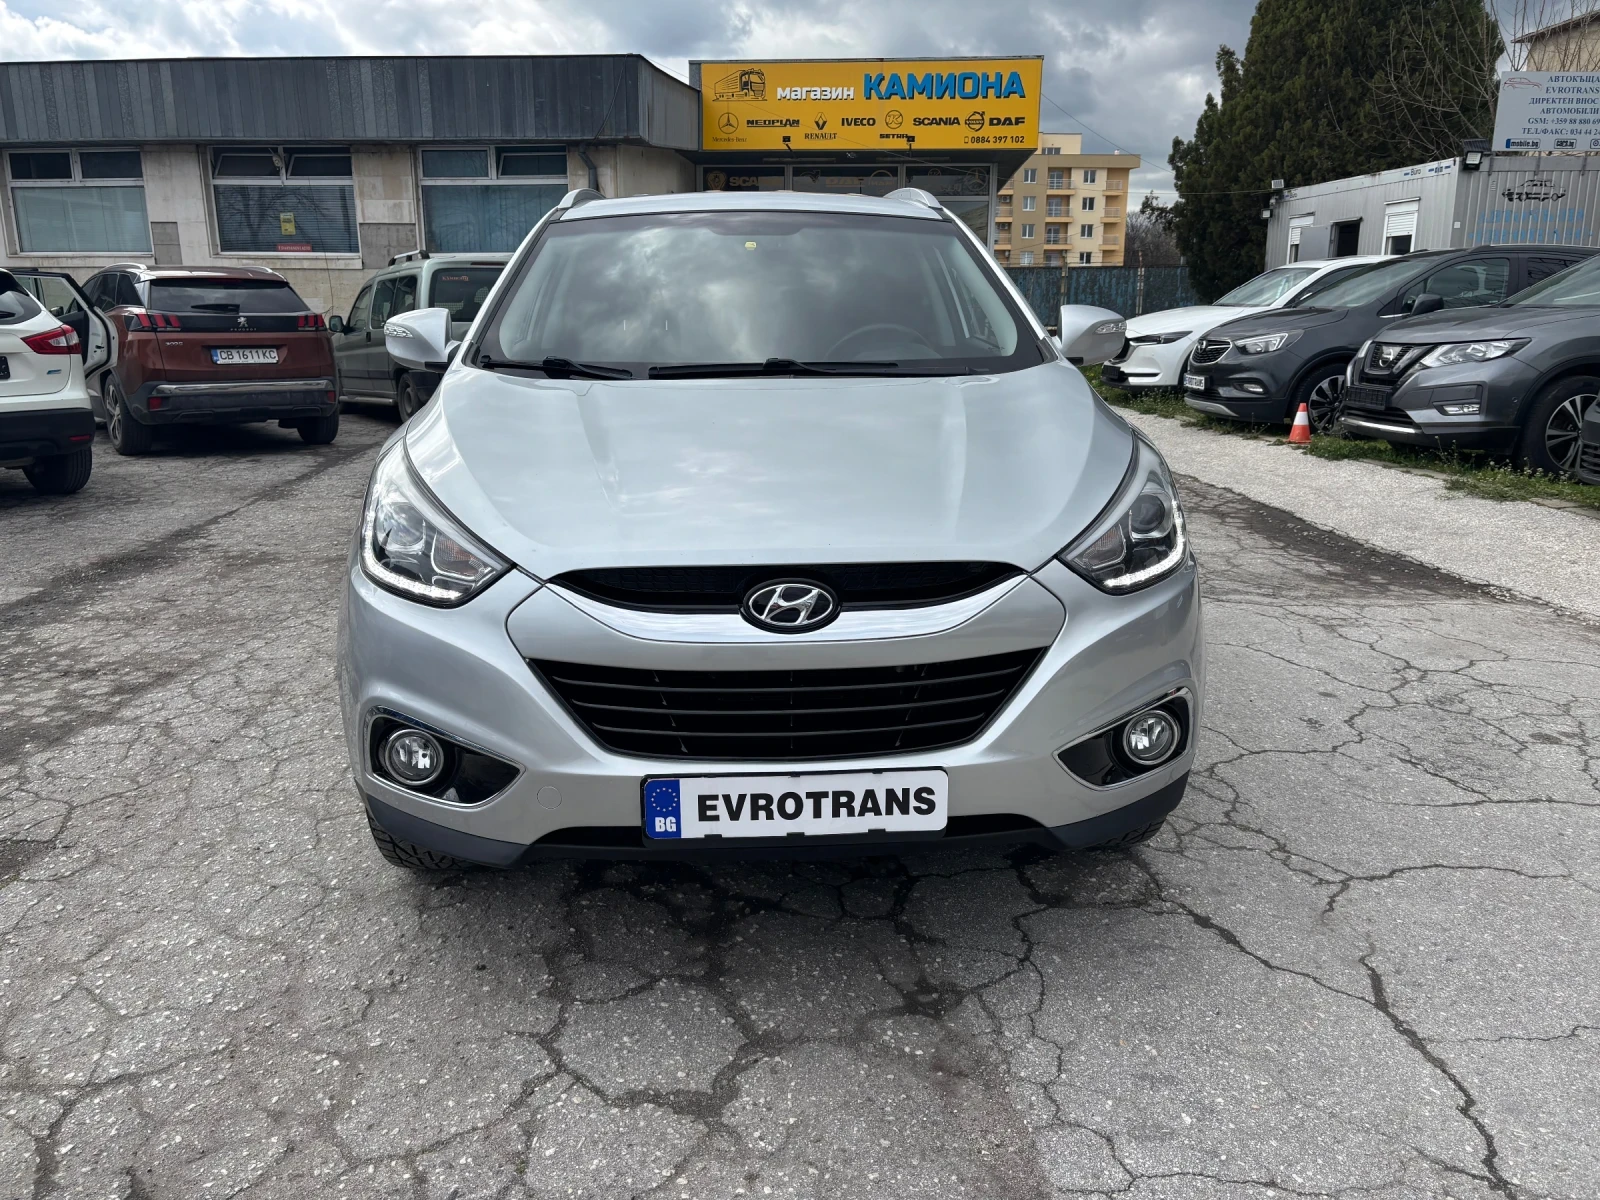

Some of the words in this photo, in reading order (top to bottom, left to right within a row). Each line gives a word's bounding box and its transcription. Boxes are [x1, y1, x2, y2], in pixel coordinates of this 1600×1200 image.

[1547, 75, 1600, 84] АВТОКЪЩА
[776, 86, 855, 101] магазин
[863, 71, 1026, 100] КАМИОНА
[1545, 86, 1600, 94] EVROTRANS
[1528, 97, 1574, 105] ДИРЕКТЕН
[1575, 97, 1599, 105] ВНОС
[1539, 107, 1599, 115] АВТОМОБИЛИ
[746, 118, 800, 127] NEOPLAN
[841, 117, 876, 126] IVECO
[912, 117, 961, 126] SCANIA
[989, 116, 1026, 126] DAF
[1527, 117, 1549, 125] GSM:
[804, 132, 837, 140] RENAULT
[970, 136, 991, 144] 0884
[992, 136, 1008, 144] 397
[1010, 135, 1025, 144] 102
[219, 349, 234, 360] CB
[236, 349, 260, 360] 1611
[261, 349, 277, 359] KC
[697, 786, 936, 822] EVROTRANS
[654, 816, 677, 832] BG
